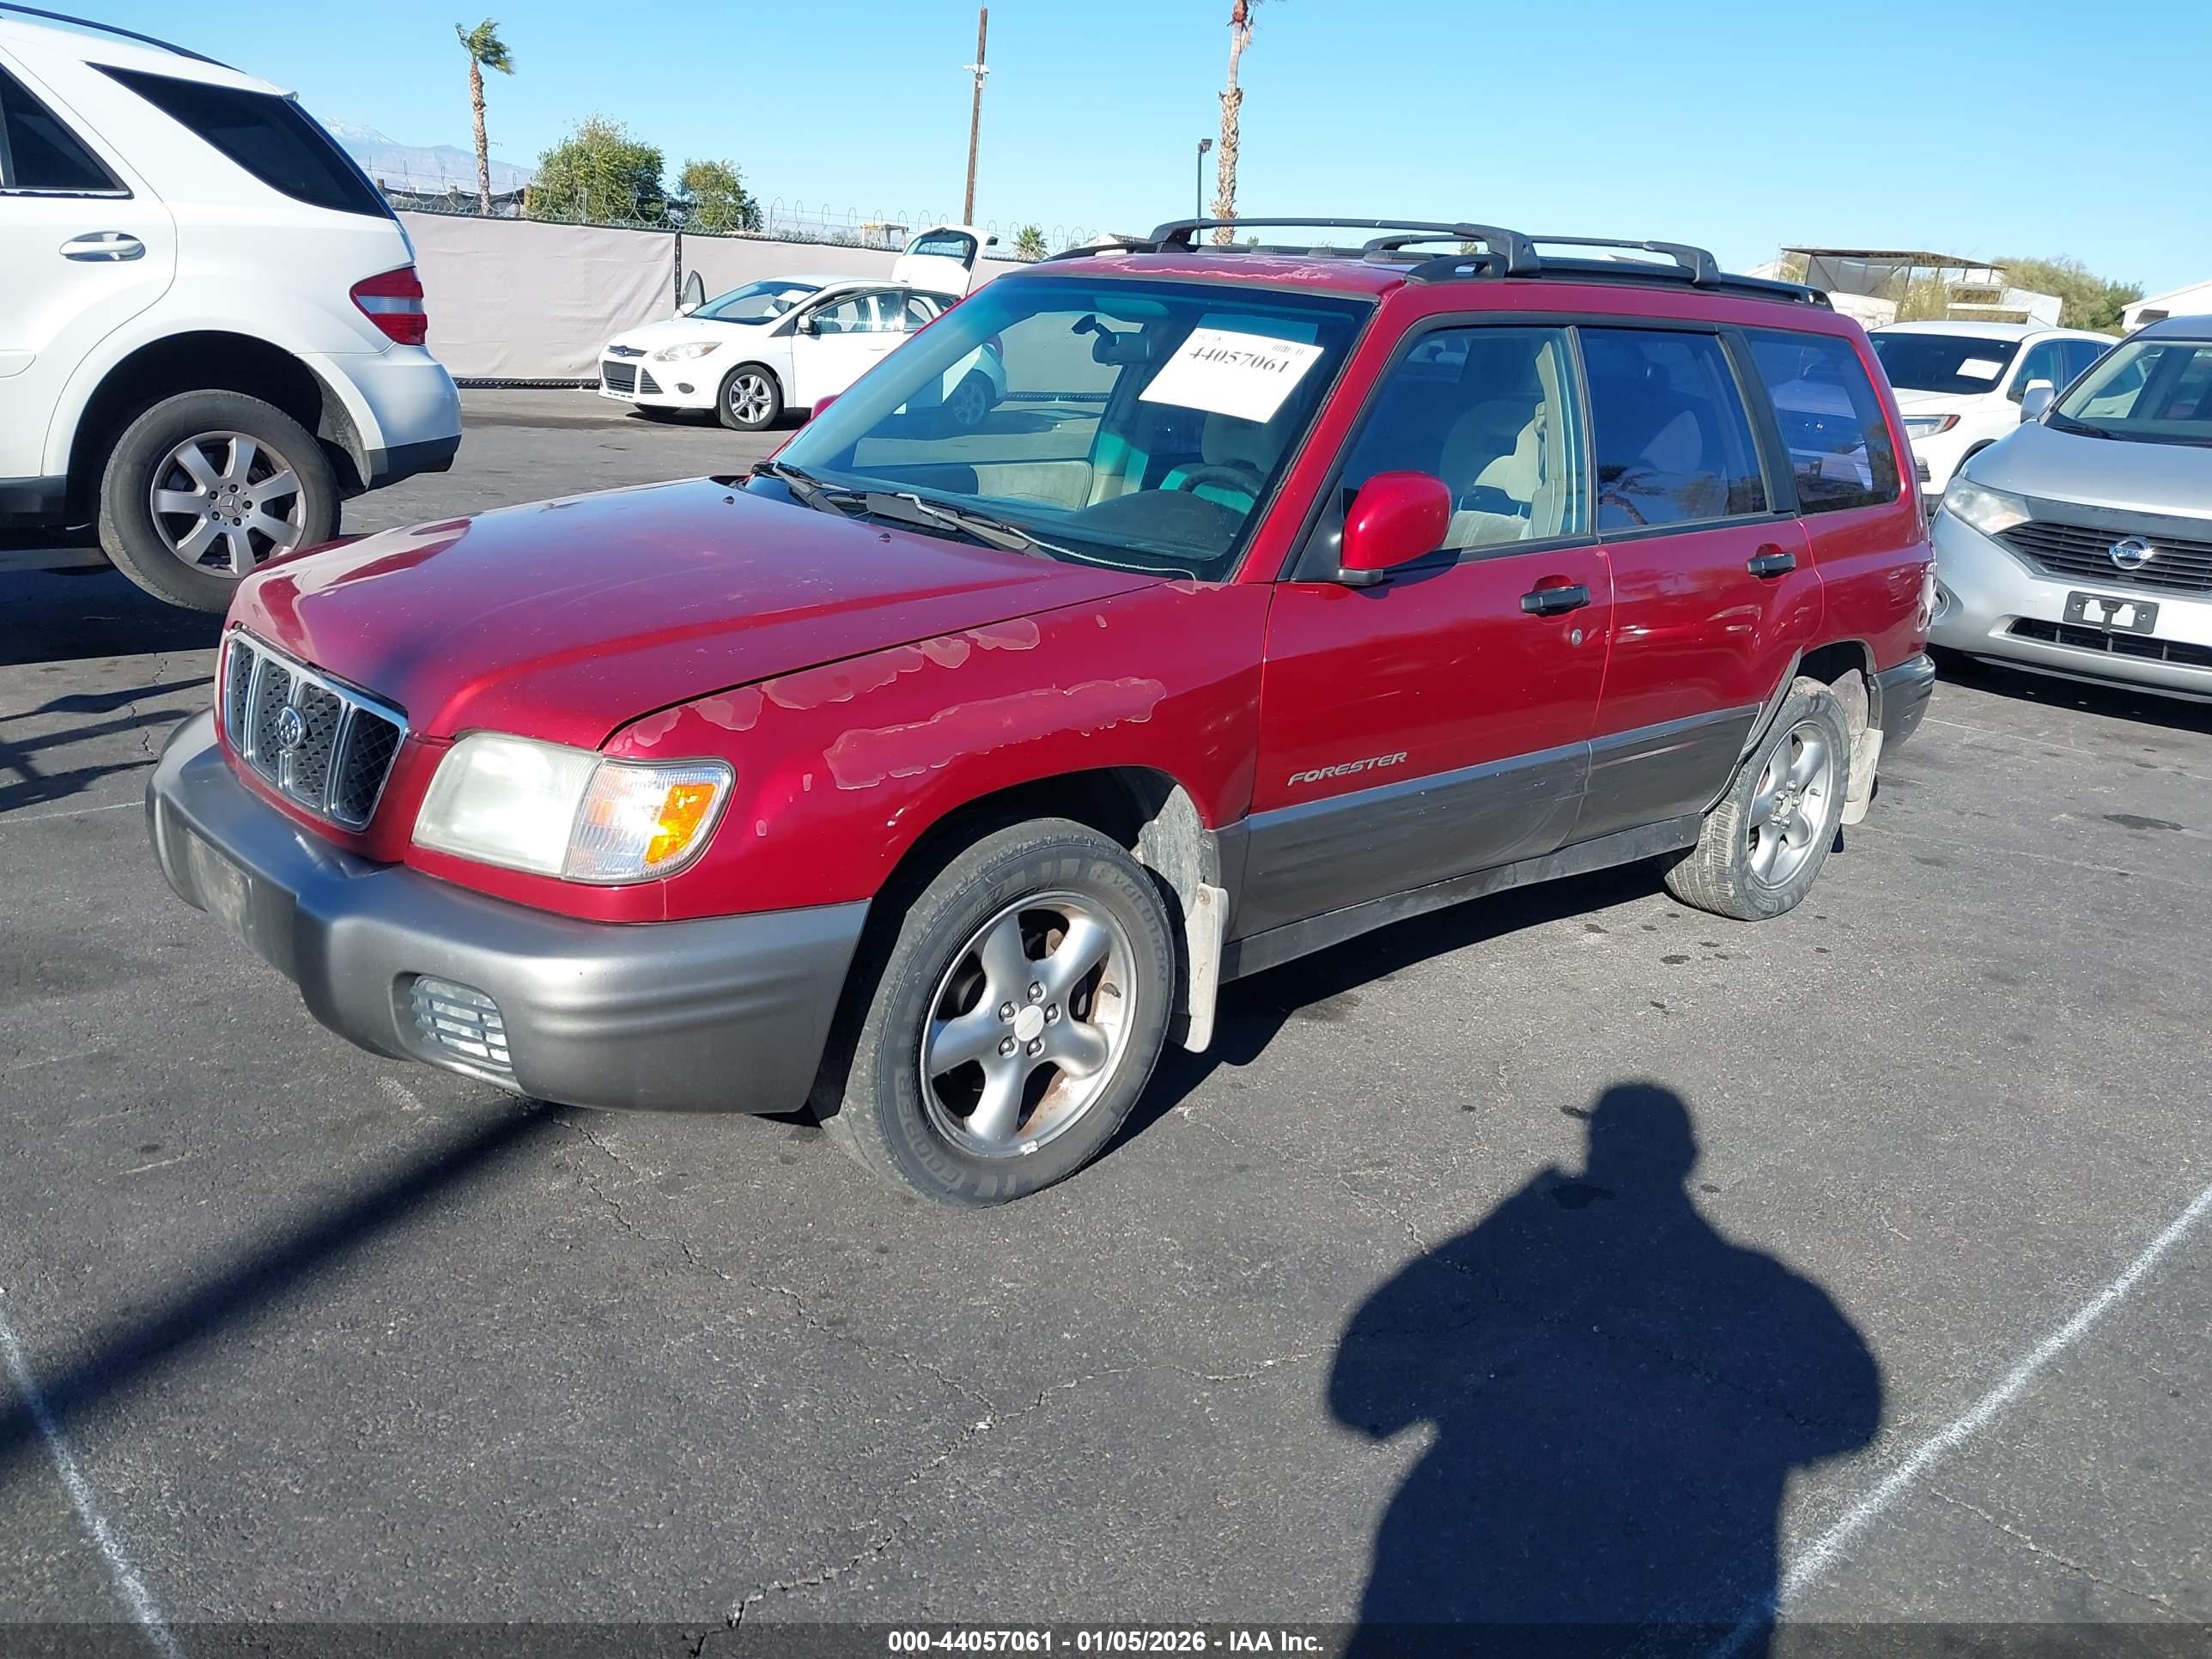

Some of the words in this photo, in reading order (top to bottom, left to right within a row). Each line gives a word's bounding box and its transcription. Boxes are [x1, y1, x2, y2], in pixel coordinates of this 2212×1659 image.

[1188, 346, 1290, 374] 44057061
[1286, 750, 1408, 787] FORESTER
[895, 1068, 966, 1193] COOPER
